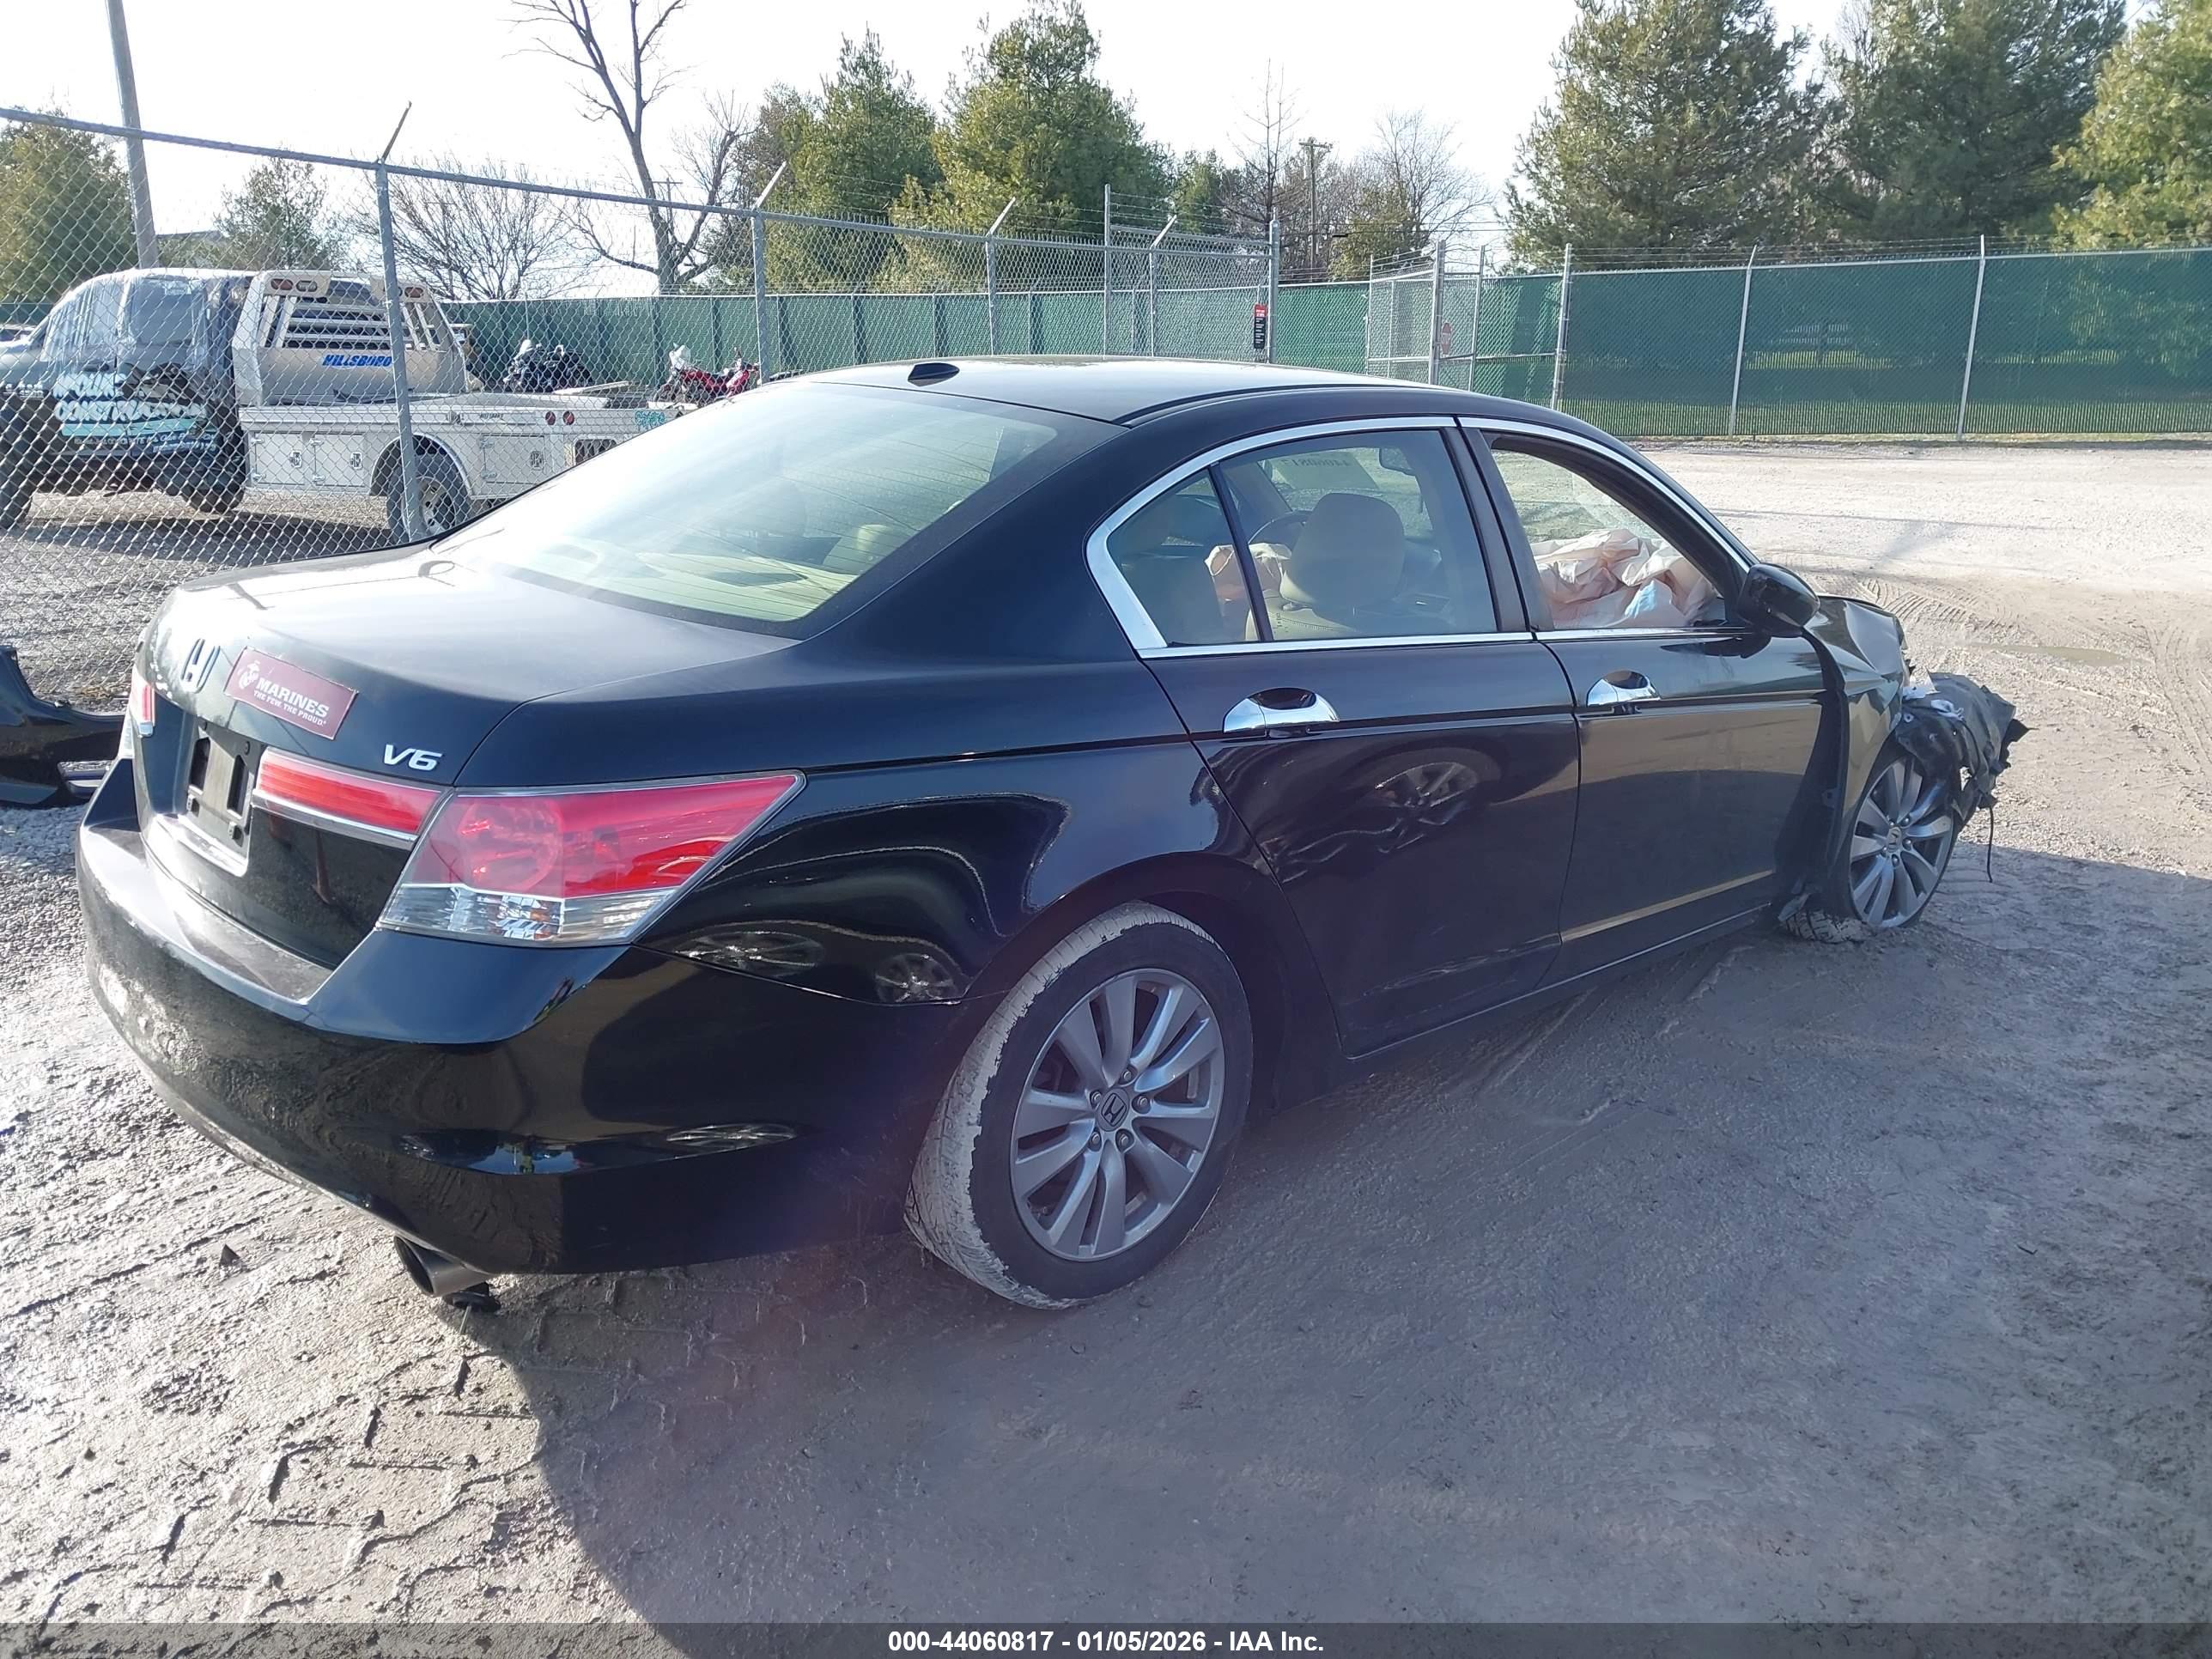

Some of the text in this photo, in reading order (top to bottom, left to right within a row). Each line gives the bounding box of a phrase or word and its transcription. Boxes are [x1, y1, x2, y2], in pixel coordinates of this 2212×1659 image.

[253, 690, 265, 701] THE
[283, 703, 296, 715] THE
[255, 677, 330, 719] MARINES
[383, 744, 443, 771] V6
